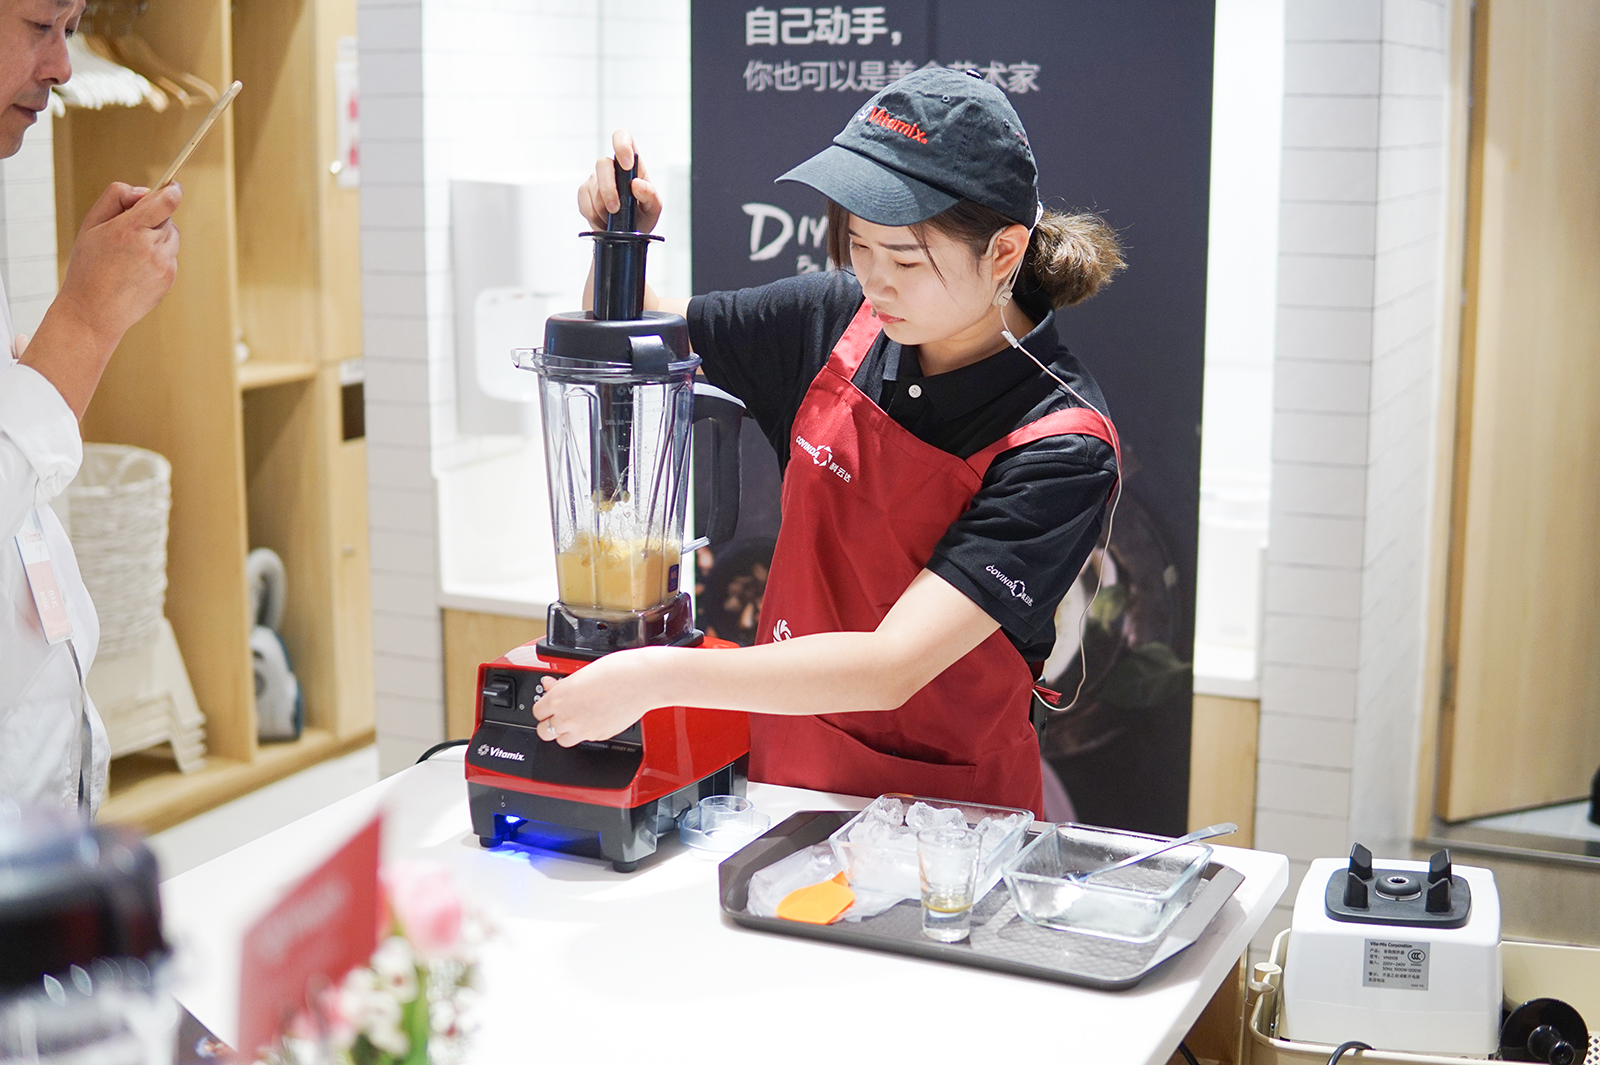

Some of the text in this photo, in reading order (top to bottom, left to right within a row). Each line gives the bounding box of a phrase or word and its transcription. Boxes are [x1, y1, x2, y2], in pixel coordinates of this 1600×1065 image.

[745, 6, 902, 46] 自己动手，
[868, 106, 926, 143] Vitamix
[490, 746, 525, 761] Vitamix
